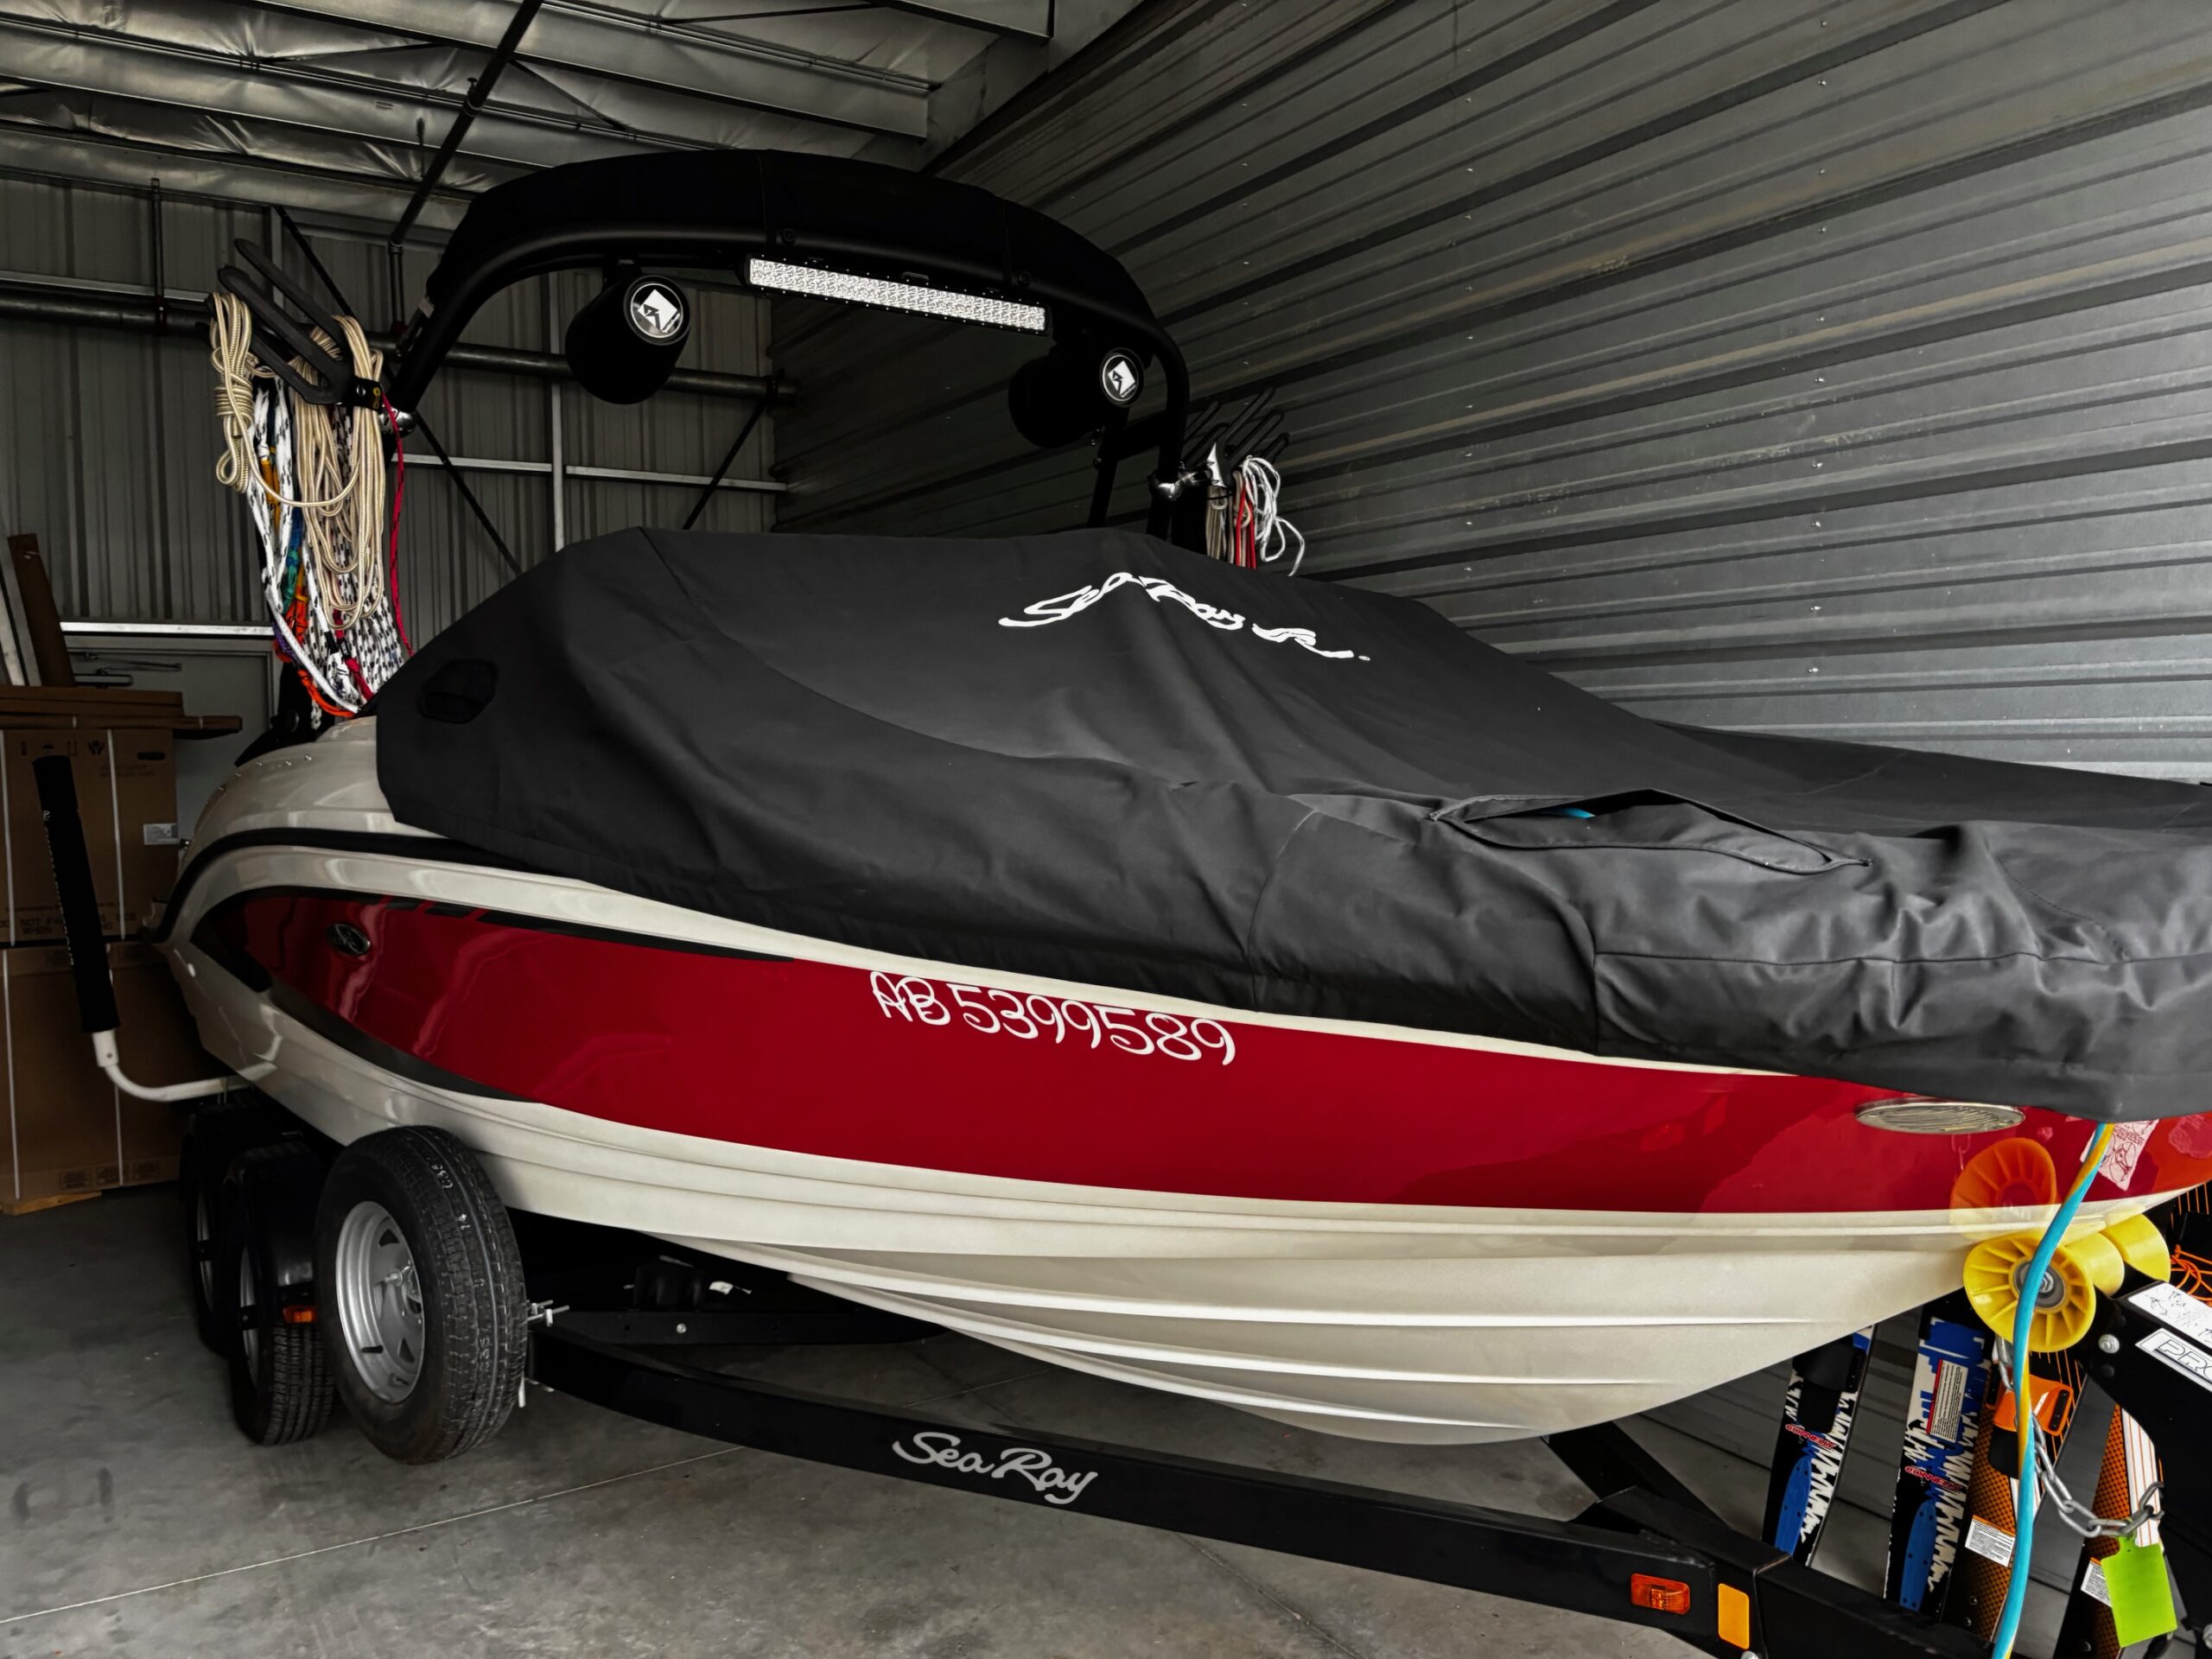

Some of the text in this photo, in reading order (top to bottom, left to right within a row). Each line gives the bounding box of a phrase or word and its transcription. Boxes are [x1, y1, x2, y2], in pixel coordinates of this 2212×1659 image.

[945, 982, 1236, 1065] 5399589
[2157, 1338, 2212, 1382] PR
[1785, 1423, 1838, 1450] CONNELLY
[892, 1432, 1098, 1504] Sea Ray
[1904, 1465, 1965, 1491] CONNELLY
